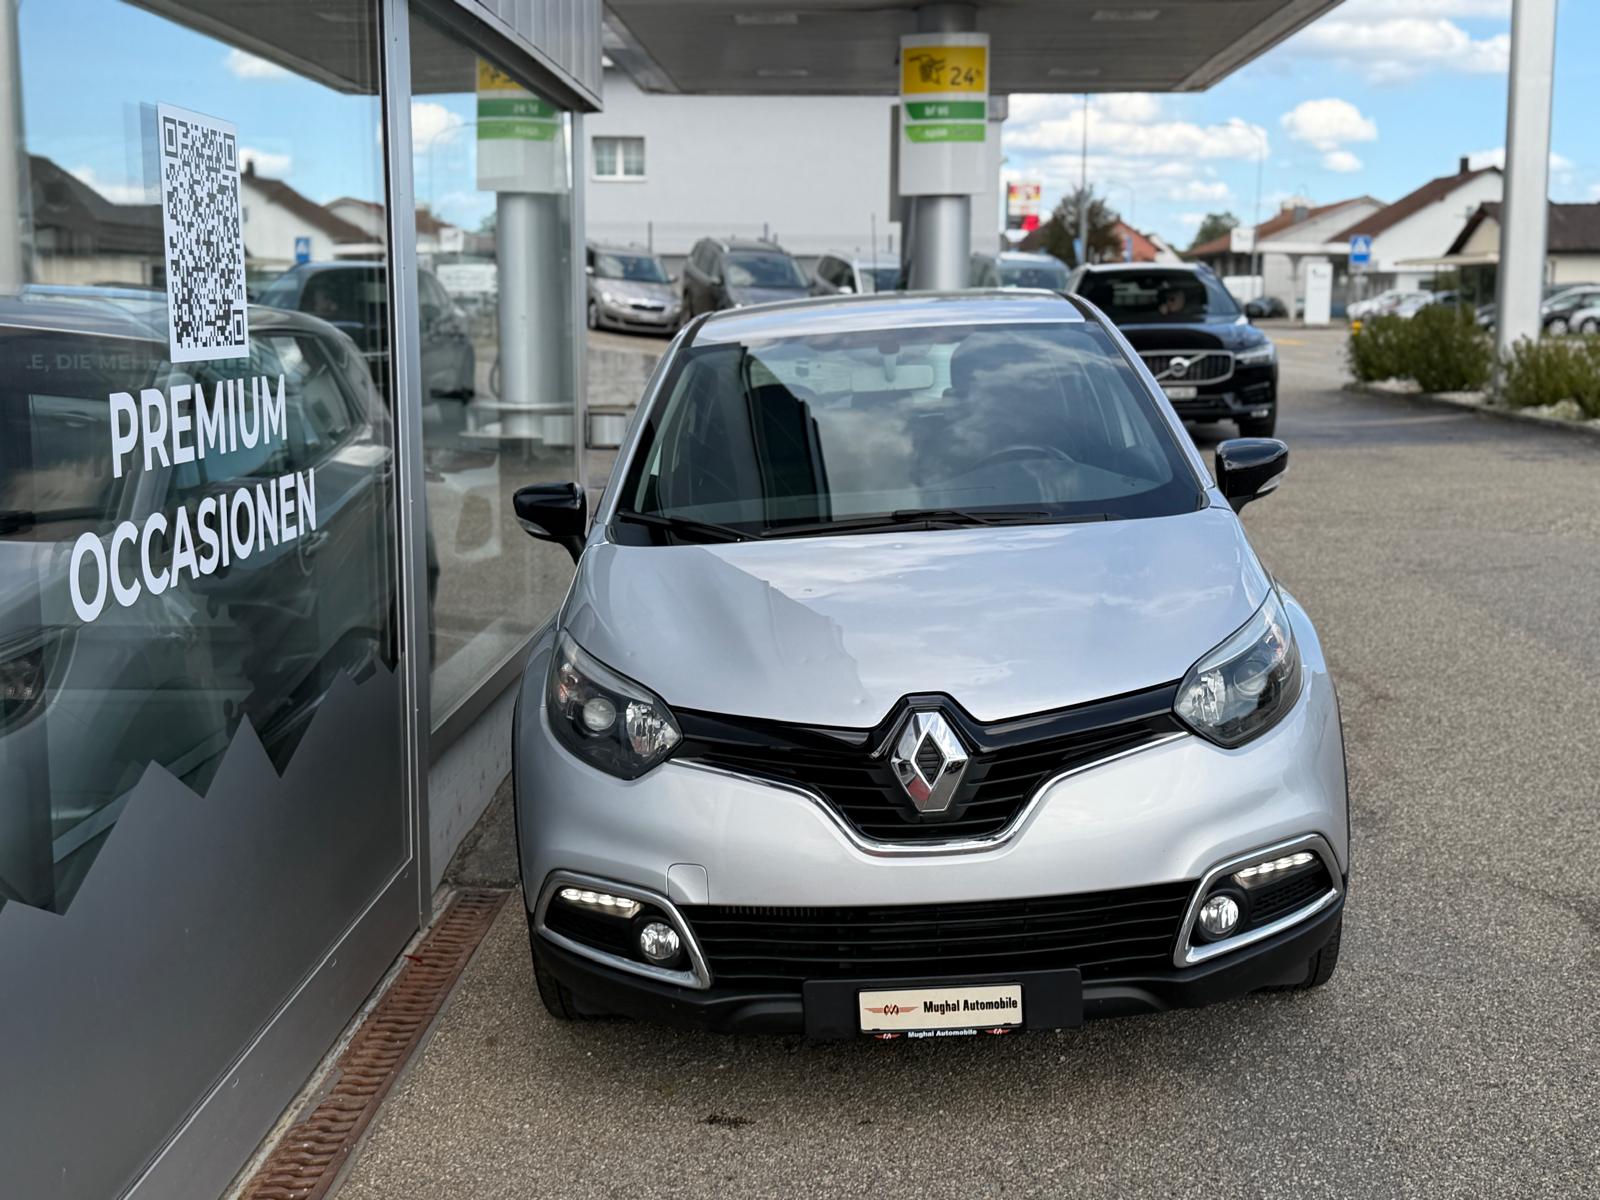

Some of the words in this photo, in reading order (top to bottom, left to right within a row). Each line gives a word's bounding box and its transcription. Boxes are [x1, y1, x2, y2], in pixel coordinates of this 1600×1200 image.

[55, 353, 91, 370] DIE
[109, 374, 288, 478] PREMIUM
[69, 468, 317, 622] OCCASIONEN
[923, 1000, 960, 1015] Mughal
[963, 997, 1018, 1011] Automobile
[907, 1031, 935, 1039] Mughal
[935, 1028, 978, 1038] Automobile
